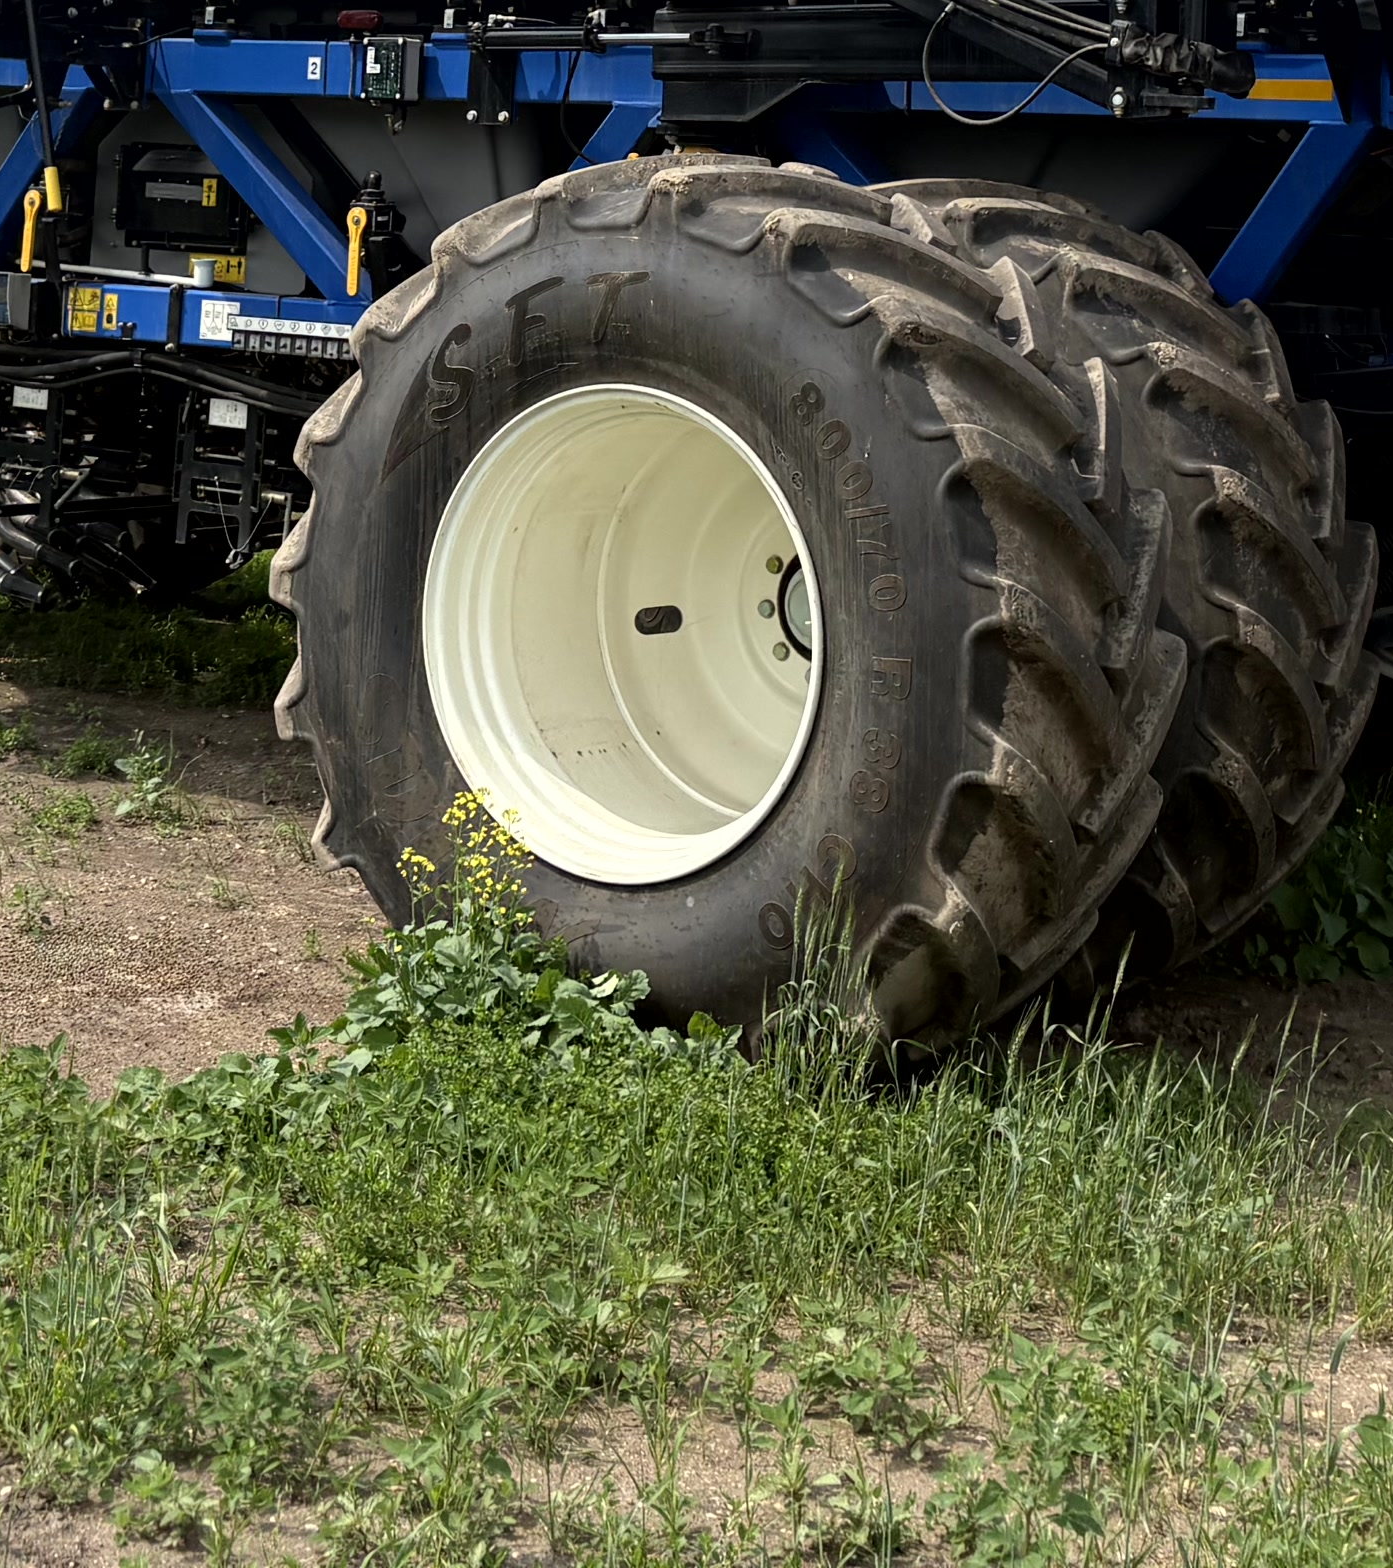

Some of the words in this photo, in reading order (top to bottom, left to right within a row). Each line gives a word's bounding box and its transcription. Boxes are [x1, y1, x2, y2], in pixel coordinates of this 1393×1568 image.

[310, 61, 318, 76] 2
[788, 379, 909, 613] 800/70
[867, 655, 914, 704] R
[849, 726, 904, 814] 38
